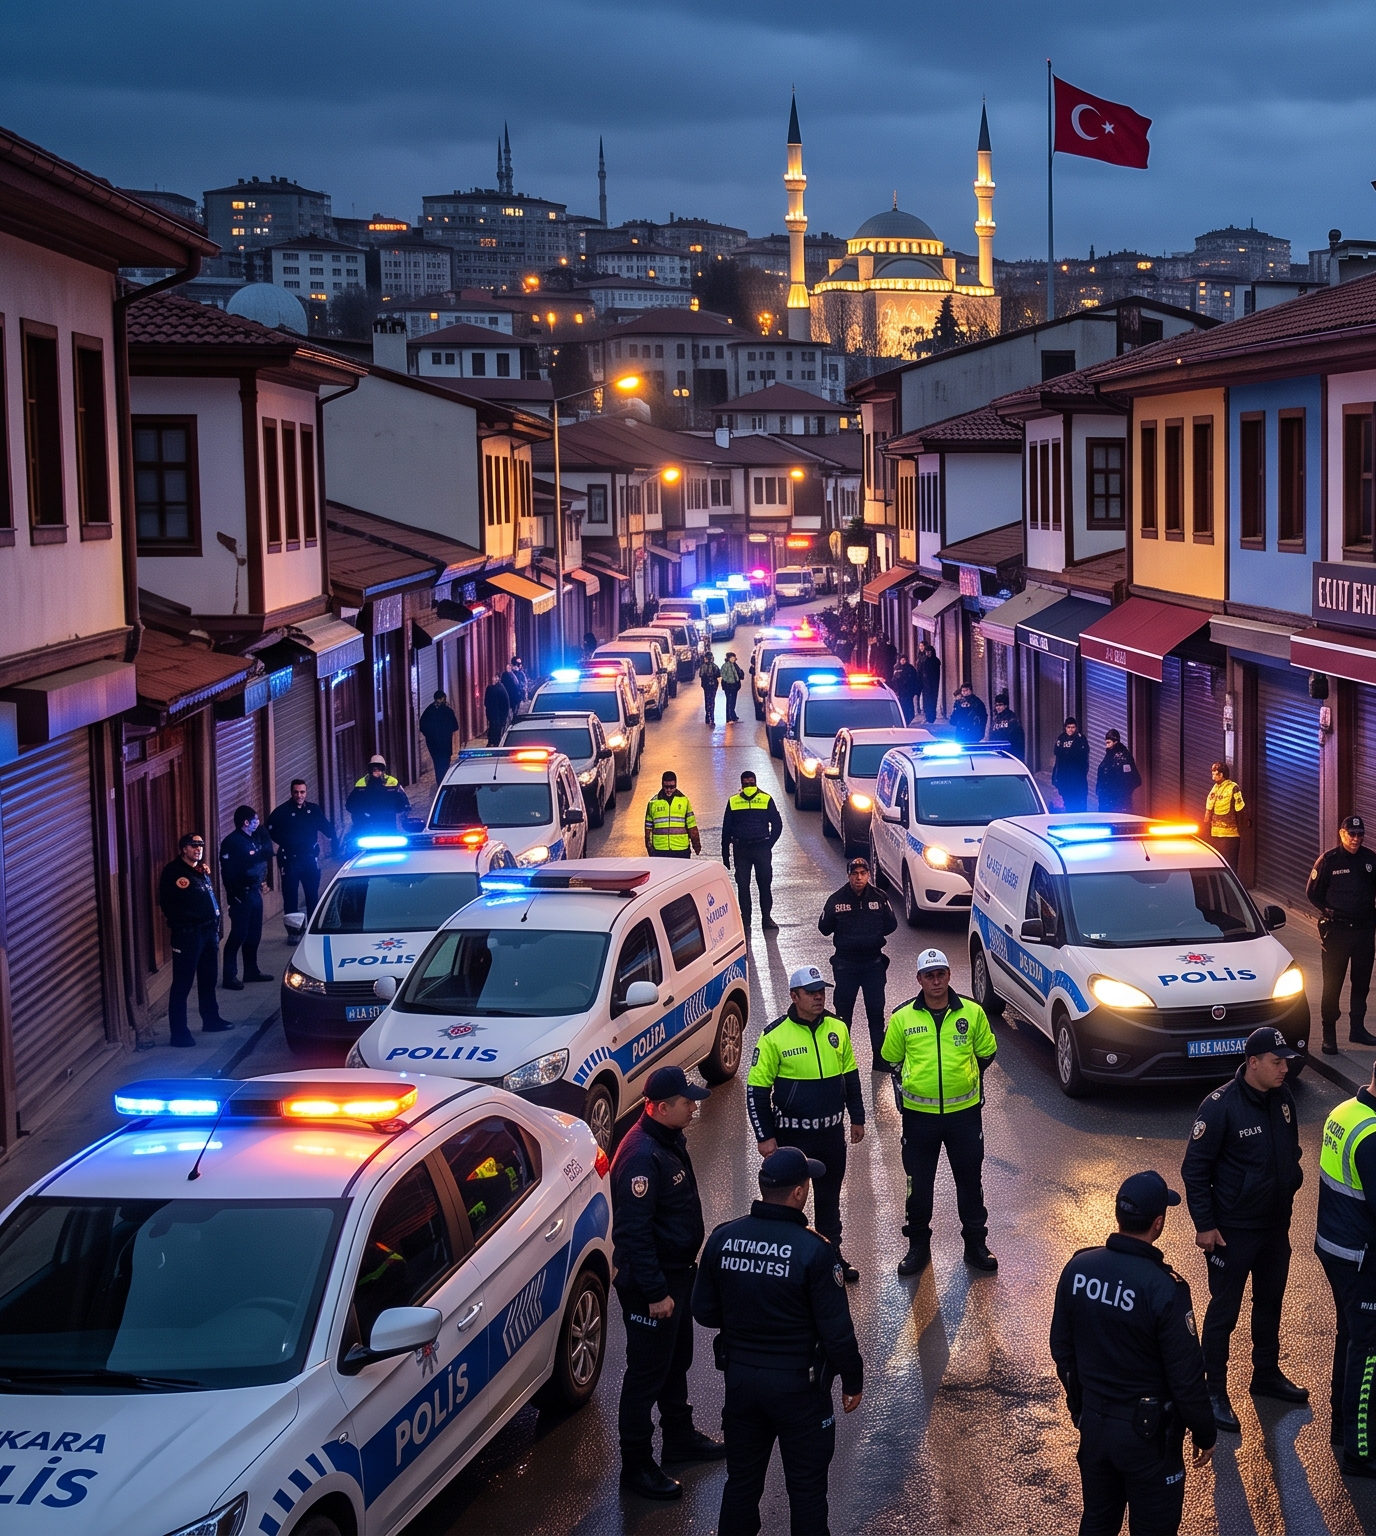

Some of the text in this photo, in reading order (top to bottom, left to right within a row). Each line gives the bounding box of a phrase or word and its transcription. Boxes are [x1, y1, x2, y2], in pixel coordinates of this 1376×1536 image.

[1157, 967, 1257, 987] POLİS
[1072, 1273, 1136, 1311] POLİS
[395, 1362, 469, 1467] POLİS
[0, 1430, 107, 1454] KARA
[0, 1456, 99, 1508] LİS
